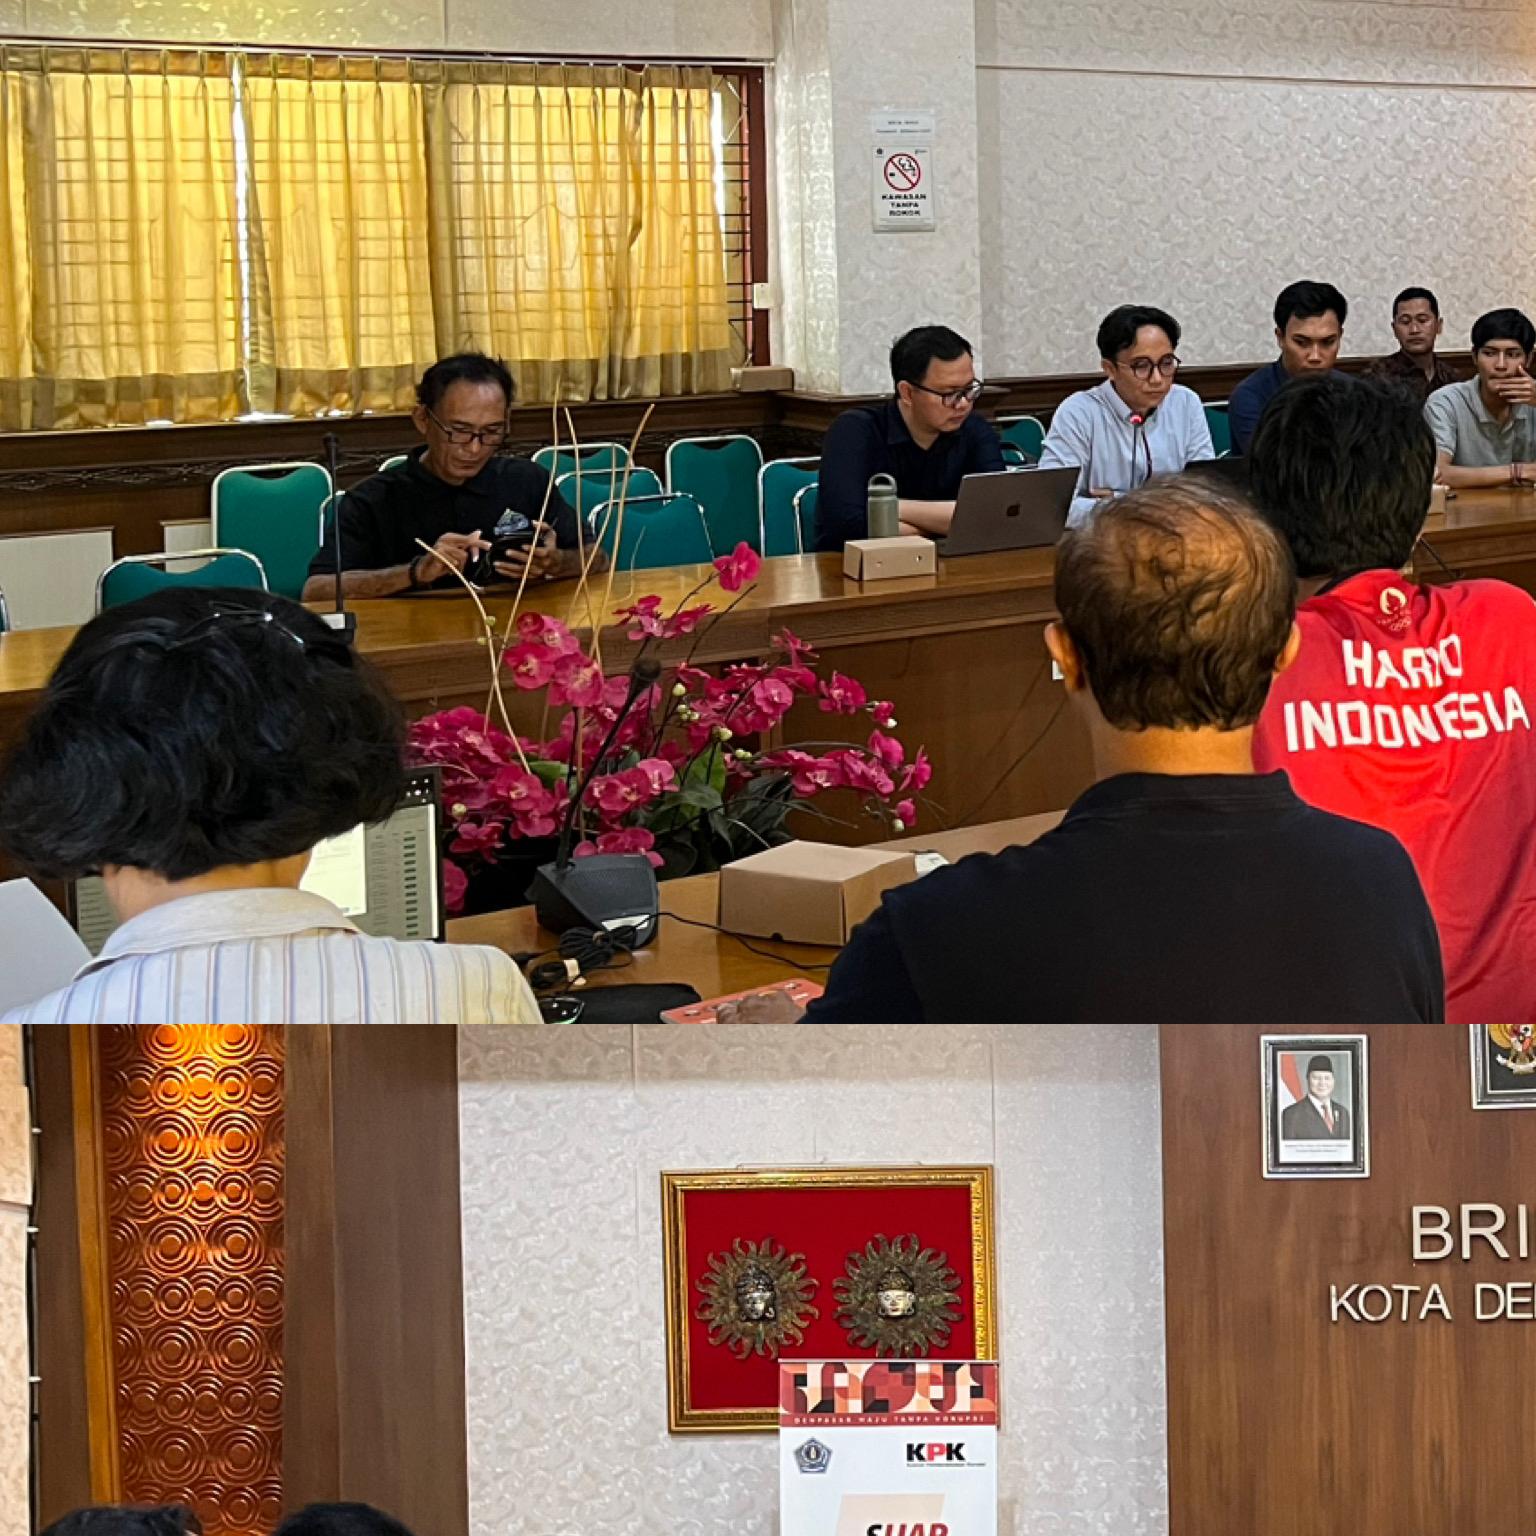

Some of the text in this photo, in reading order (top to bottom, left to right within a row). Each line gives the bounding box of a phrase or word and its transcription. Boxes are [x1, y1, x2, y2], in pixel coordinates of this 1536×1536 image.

[1283, 686, 1531, 752] INDONESIA
[1330, 1283, 1451, 1321] KOTA
[906, 1443, 966, 1462] KPK
